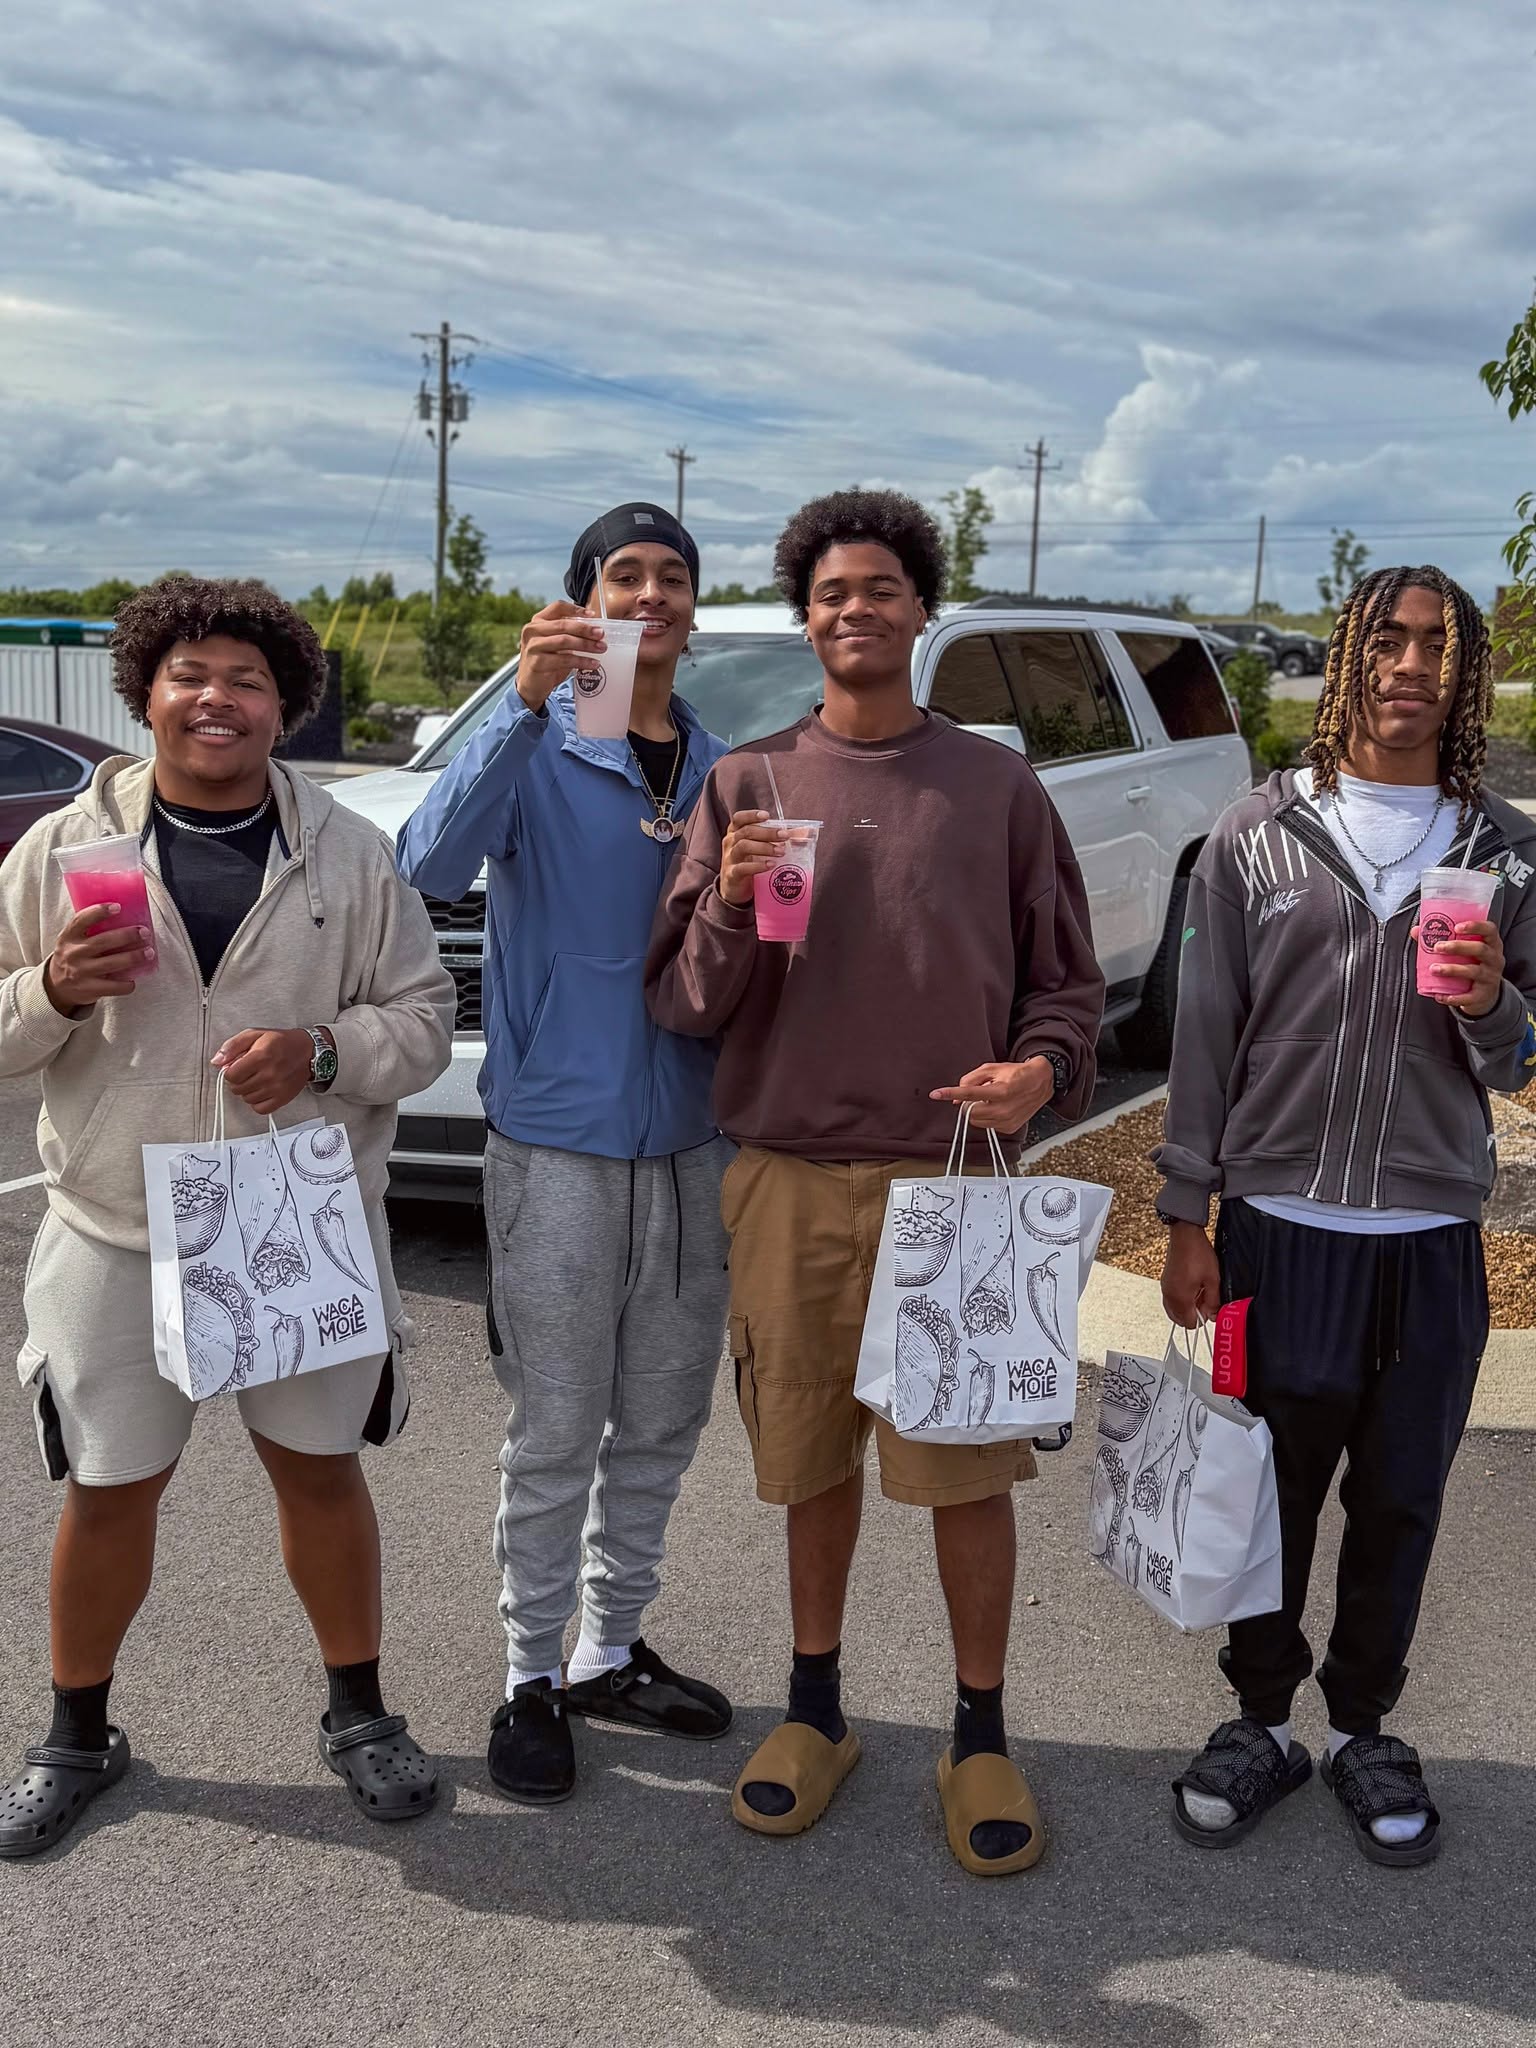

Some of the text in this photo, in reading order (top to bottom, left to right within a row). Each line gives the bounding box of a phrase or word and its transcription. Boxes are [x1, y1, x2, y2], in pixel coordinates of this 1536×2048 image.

[773, 878, 804, 887] Southern
[312, 1294, 363, 1325] WACA
[319, 1309, 367, 1346] MOLE
[1007, 1357, 1057, 1378] WACA
[1009, 1374, 1057, 1401] MOLE
[1147, 1546, 1173, 1577] WACA
